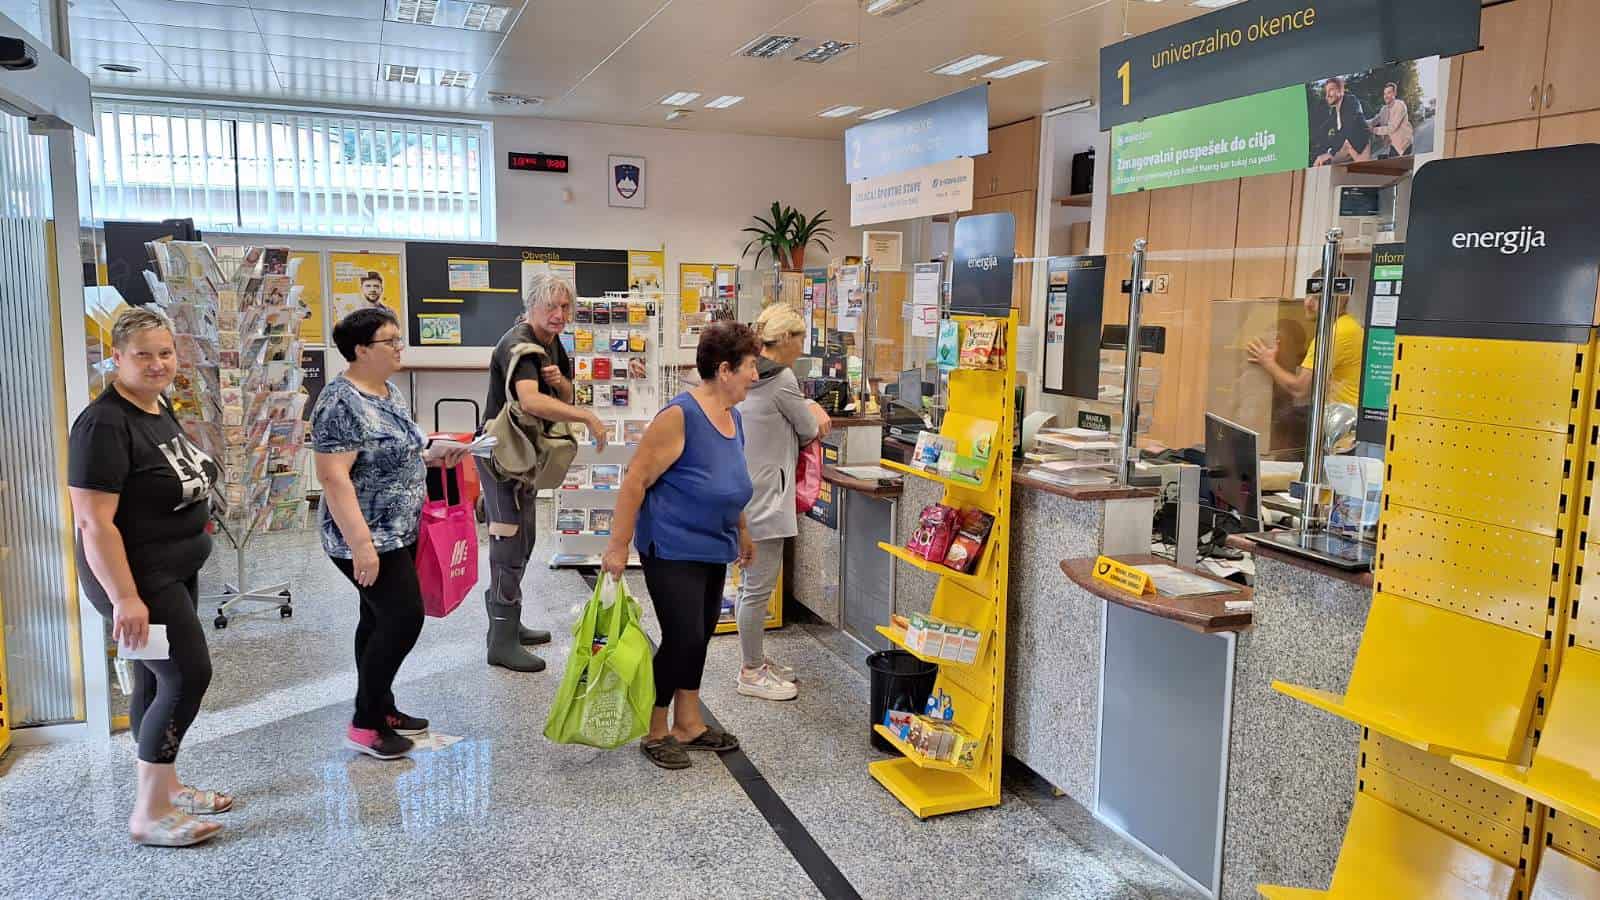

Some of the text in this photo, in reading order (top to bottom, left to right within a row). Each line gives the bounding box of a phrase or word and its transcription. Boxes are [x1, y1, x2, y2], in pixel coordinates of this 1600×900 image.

[1151, 7, 1316, 69] univerzalno okence
[1116, 60, 1131, 106] 1
[1174, 140, 1229, 165] pospešek
[1230, 135, 1246, 150] do
[1248, 130, 1276, 150] cilja
[1452, 225, 1546, 254] energija
[968, 256, 998, 271] energija
